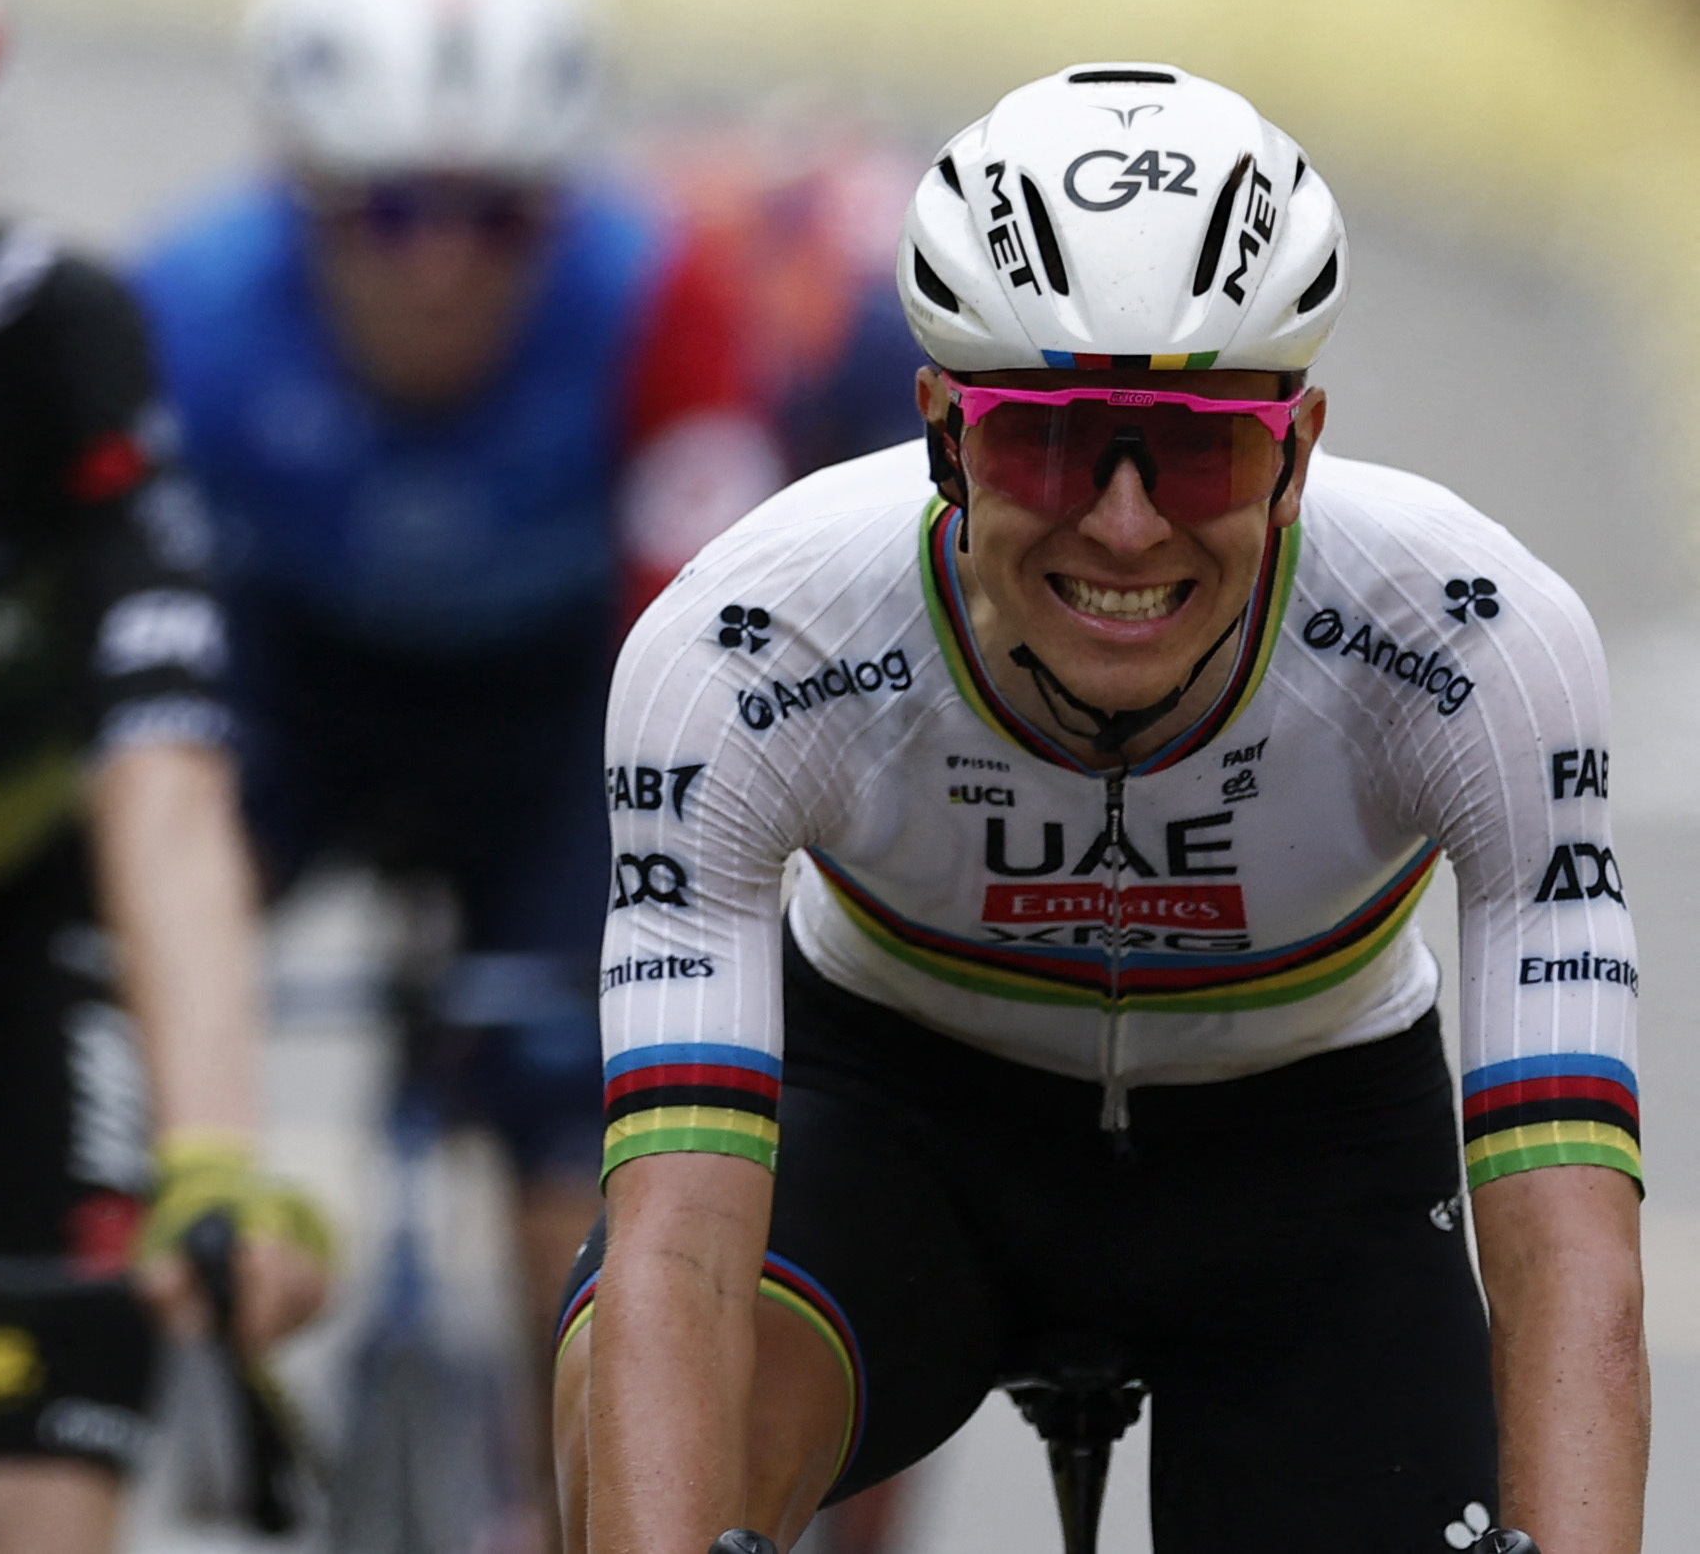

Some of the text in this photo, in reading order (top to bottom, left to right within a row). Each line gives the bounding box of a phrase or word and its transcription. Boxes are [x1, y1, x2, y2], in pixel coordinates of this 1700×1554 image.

[1064, 150, 1198, 212] G42
[985, 160, 1042, 297] MET
[1222, 159, 1277, 306] MET
[773, 648, 913, 719] Analog
[1341, 624, 1475, 716] Analog
[960, 785, 1016, 808] UCI
[985, 810, 1238, 878] UAE
[1011, 893, 1221, 921] Emirates
[602, 955, 715, 994] mirates
[1519, 951, 1639, 998] Emirate
